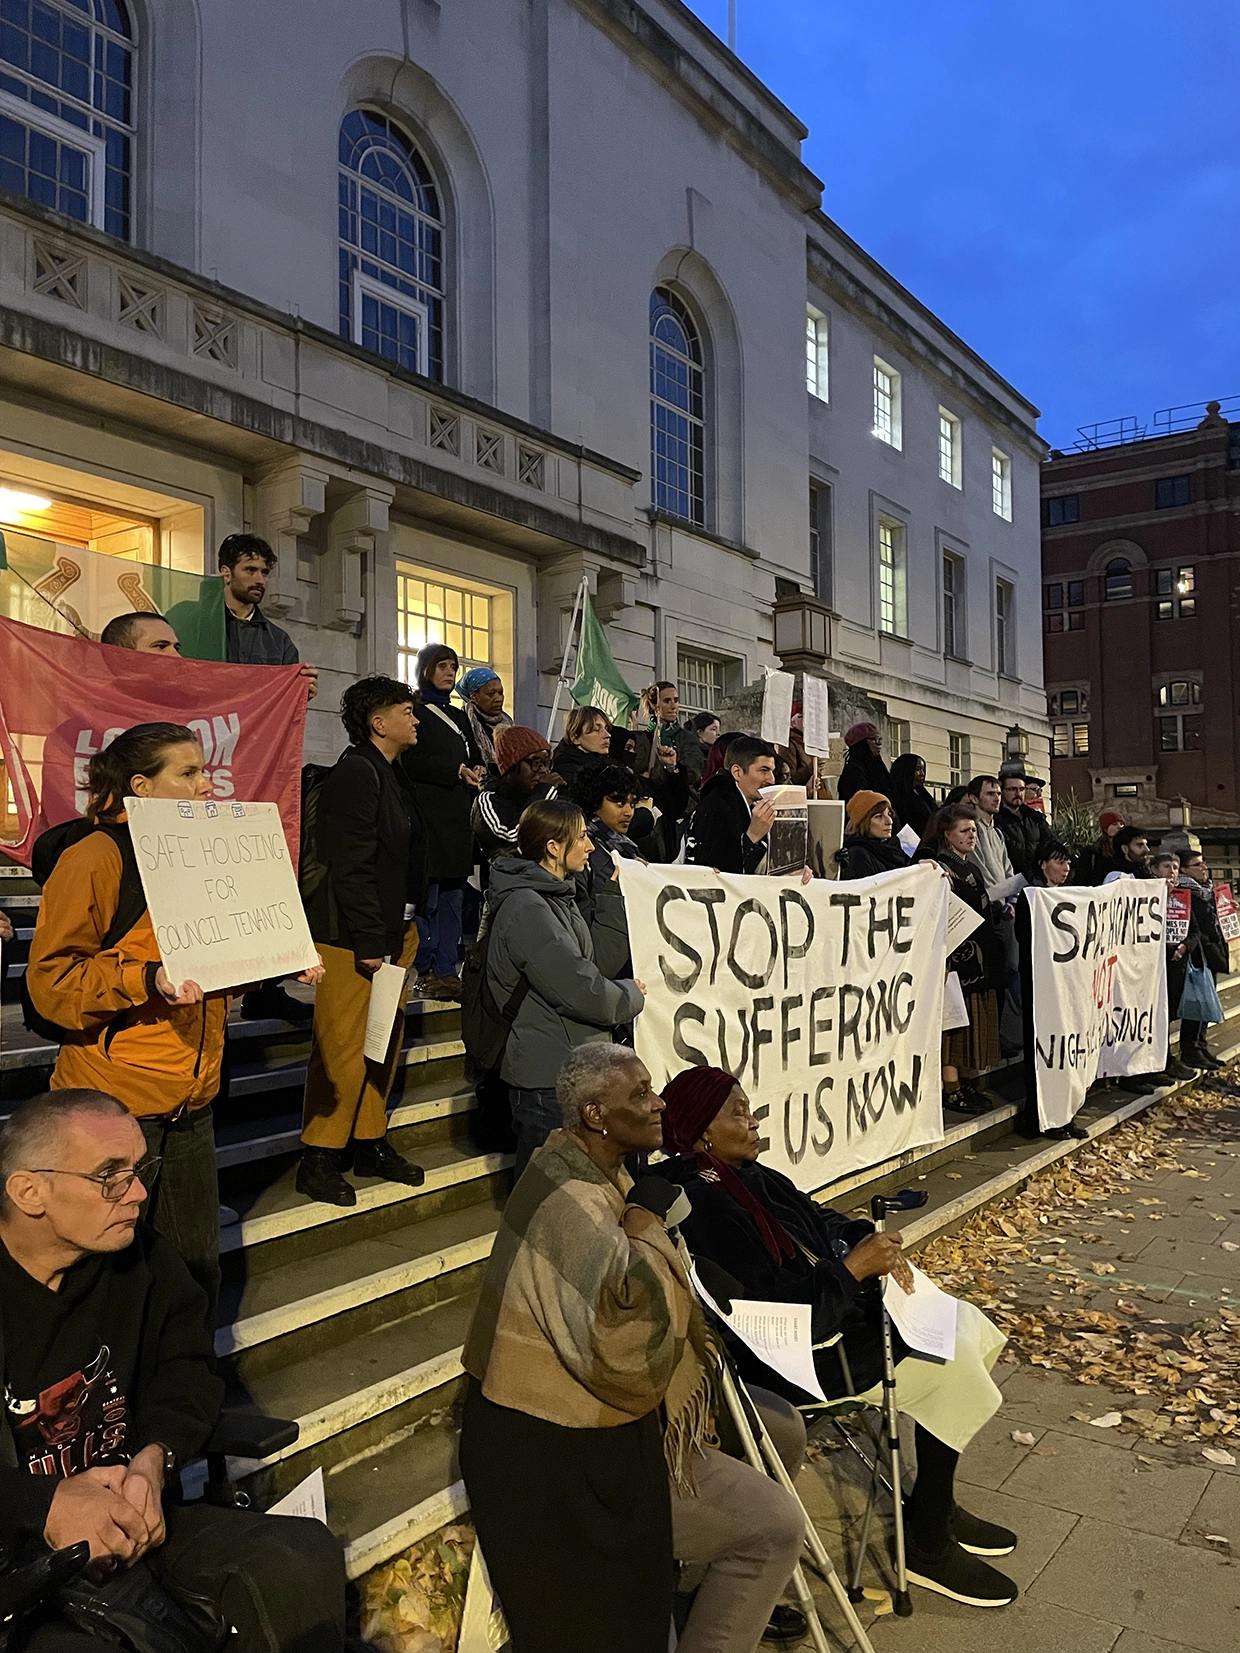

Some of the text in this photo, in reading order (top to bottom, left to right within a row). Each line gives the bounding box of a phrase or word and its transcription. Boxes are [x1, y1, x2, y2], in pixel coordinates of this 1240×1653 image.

[139, 833, 284, 871] SAFE HOUSING
[204, 875, 239, 902] FOR
[157, 902, 293, 956] COUNCIL TENANTS
[656, 885, 915, 995] STOP THE
[673, 972, 915, 1090] SUFFERING
[784, 1076, 835, 1165] US
